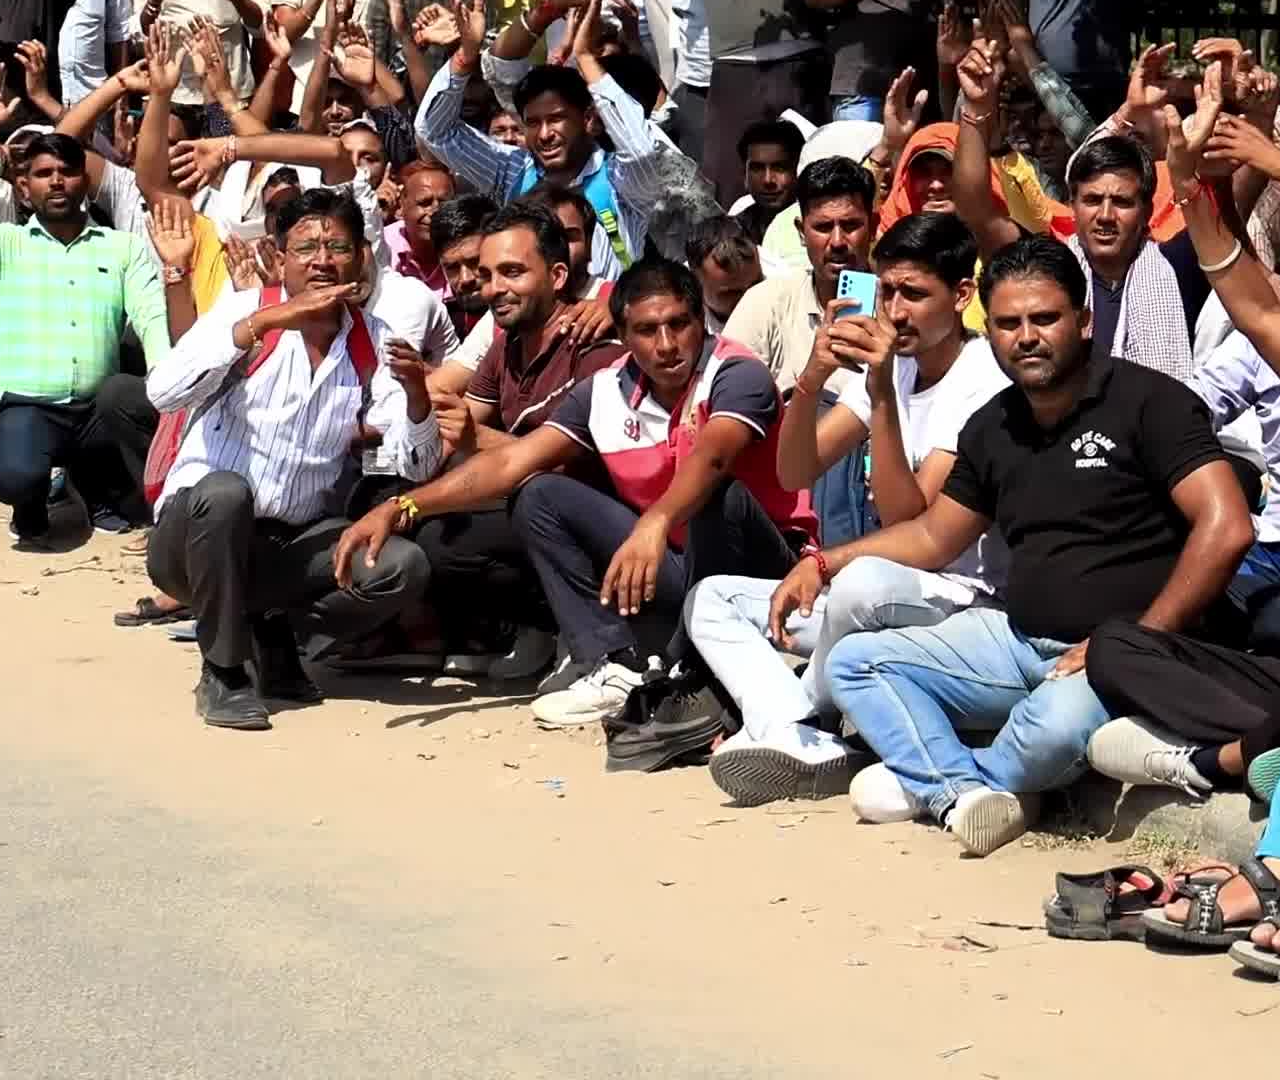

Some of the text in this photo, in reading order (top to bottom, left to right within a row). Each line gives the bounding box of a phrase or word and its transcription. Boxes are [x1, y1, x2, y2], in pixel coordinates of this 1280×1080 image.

[1081, 430, 1094, 444] EYE
[1093, 432, 1117, 451] CARE
[1075, 457, 1109, 469] HOSPITAL
